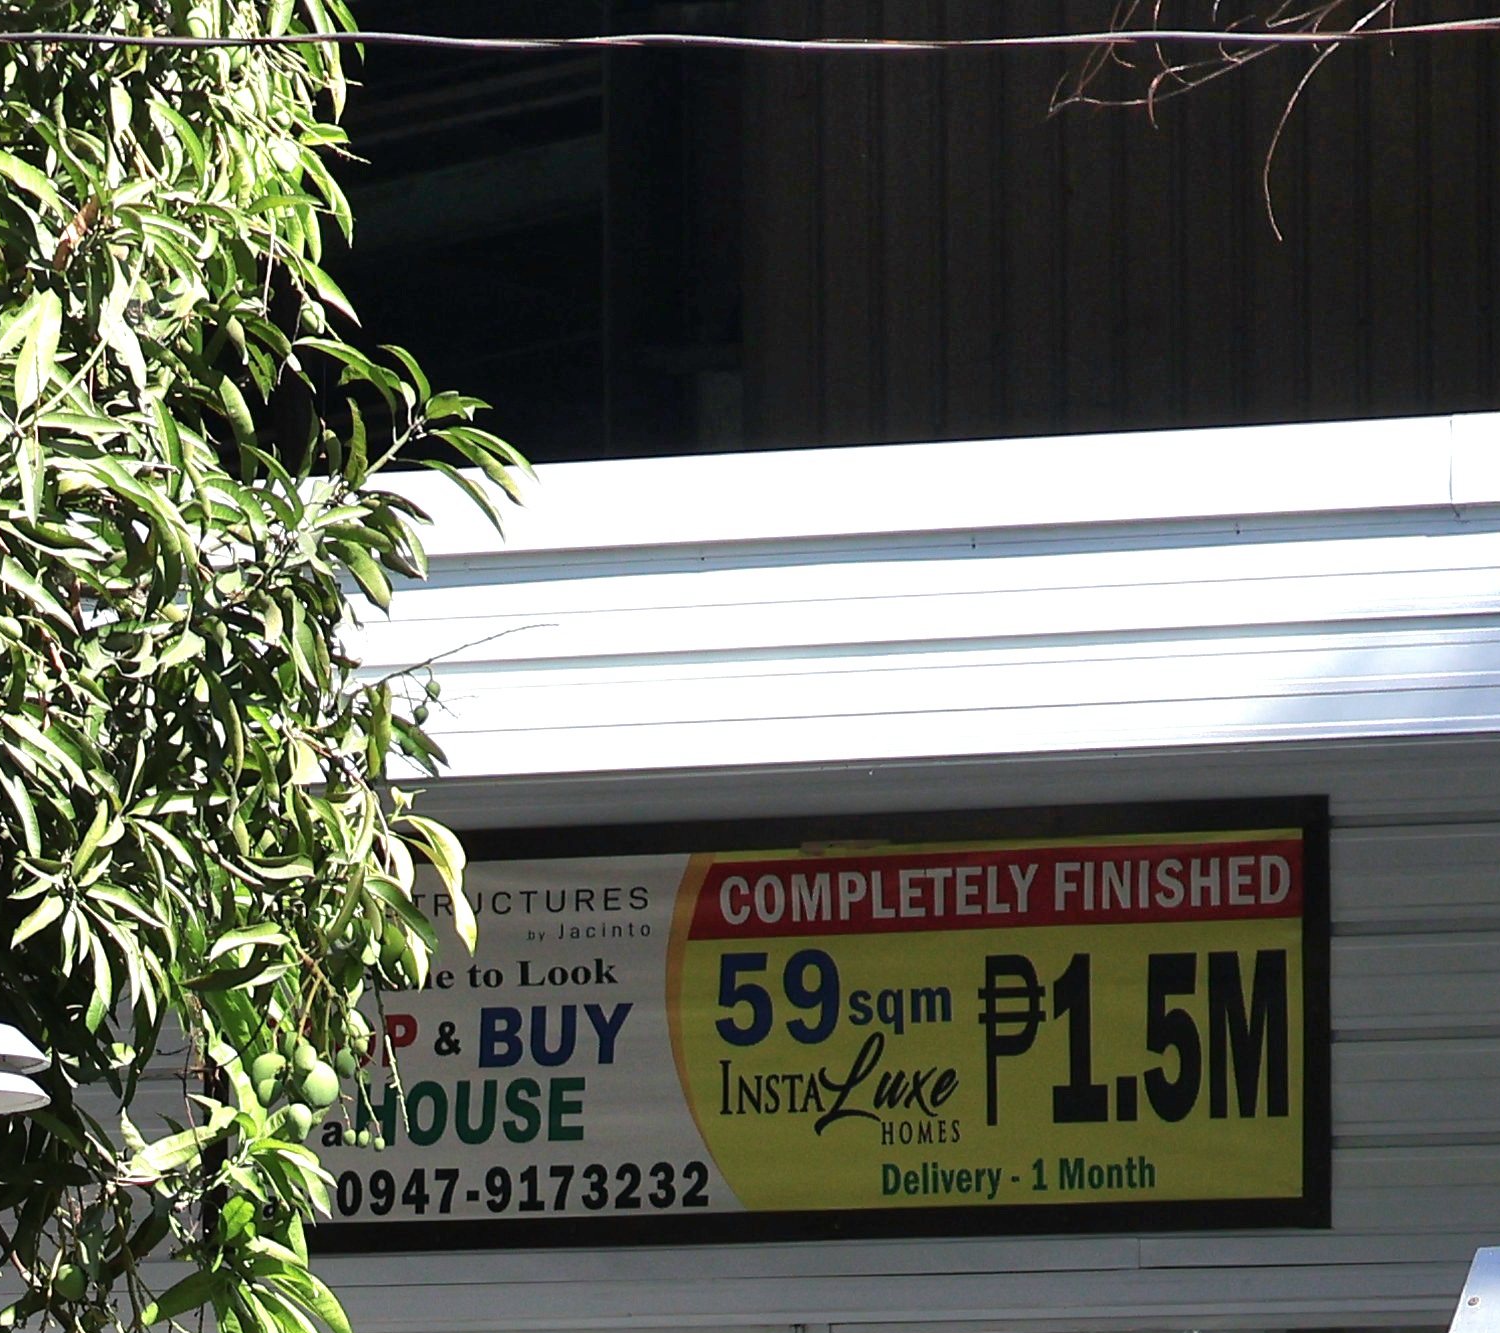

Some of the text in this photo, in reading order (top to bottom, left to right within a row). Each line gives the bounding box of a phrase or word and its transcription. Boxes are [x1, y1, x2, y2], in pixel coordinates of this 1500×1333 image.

[719, 855, 1291, 925] COMPLETELY FINISHED
[528, 922, 652, 944] by Jacinto
[468, 965, 503, 988] to
[516, 958, 618, 987] Look
[434, 1021, 461, 1056] &
[479, 1002, 634, 1069] BUY
[356, 1077, 586, 1148] HOUSE
[881, 1120, 961, 1145] HOMES
[337, 1161, 710, 1217] 0947-9173232
[882, 1162, 1002, 1199] Delivery
[1031, 1157, 1048, 1191] 1
[1059, 1156, 1155, 1190] Month
